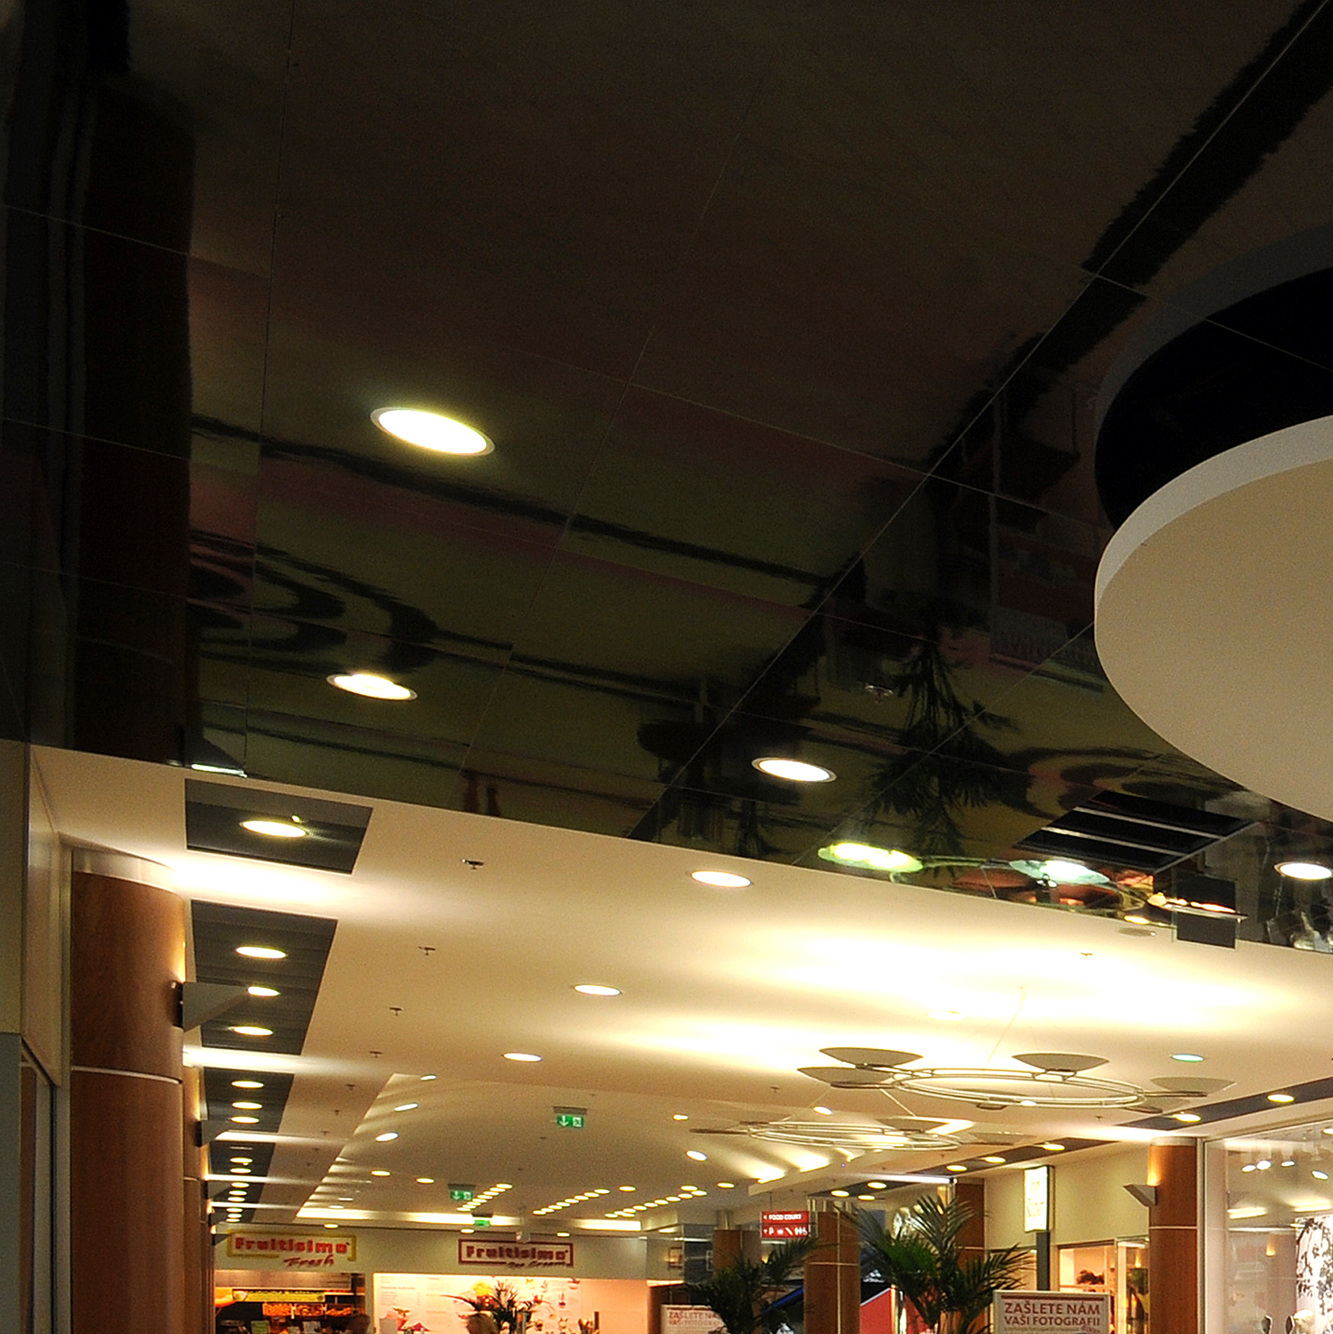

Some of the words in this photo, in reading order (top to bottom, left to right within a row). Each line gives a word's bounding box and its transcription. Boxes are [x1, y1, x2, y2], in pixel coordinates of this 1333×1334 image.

[1004, 1300, 1063, 1314] ZAŠLETE
[1066, 1301, 1100, 1315] NÁM
[1004, 1315, 1030, 1326] VAŠI
[1033, 1316, 1100, 1326] FOTOGRAFII
